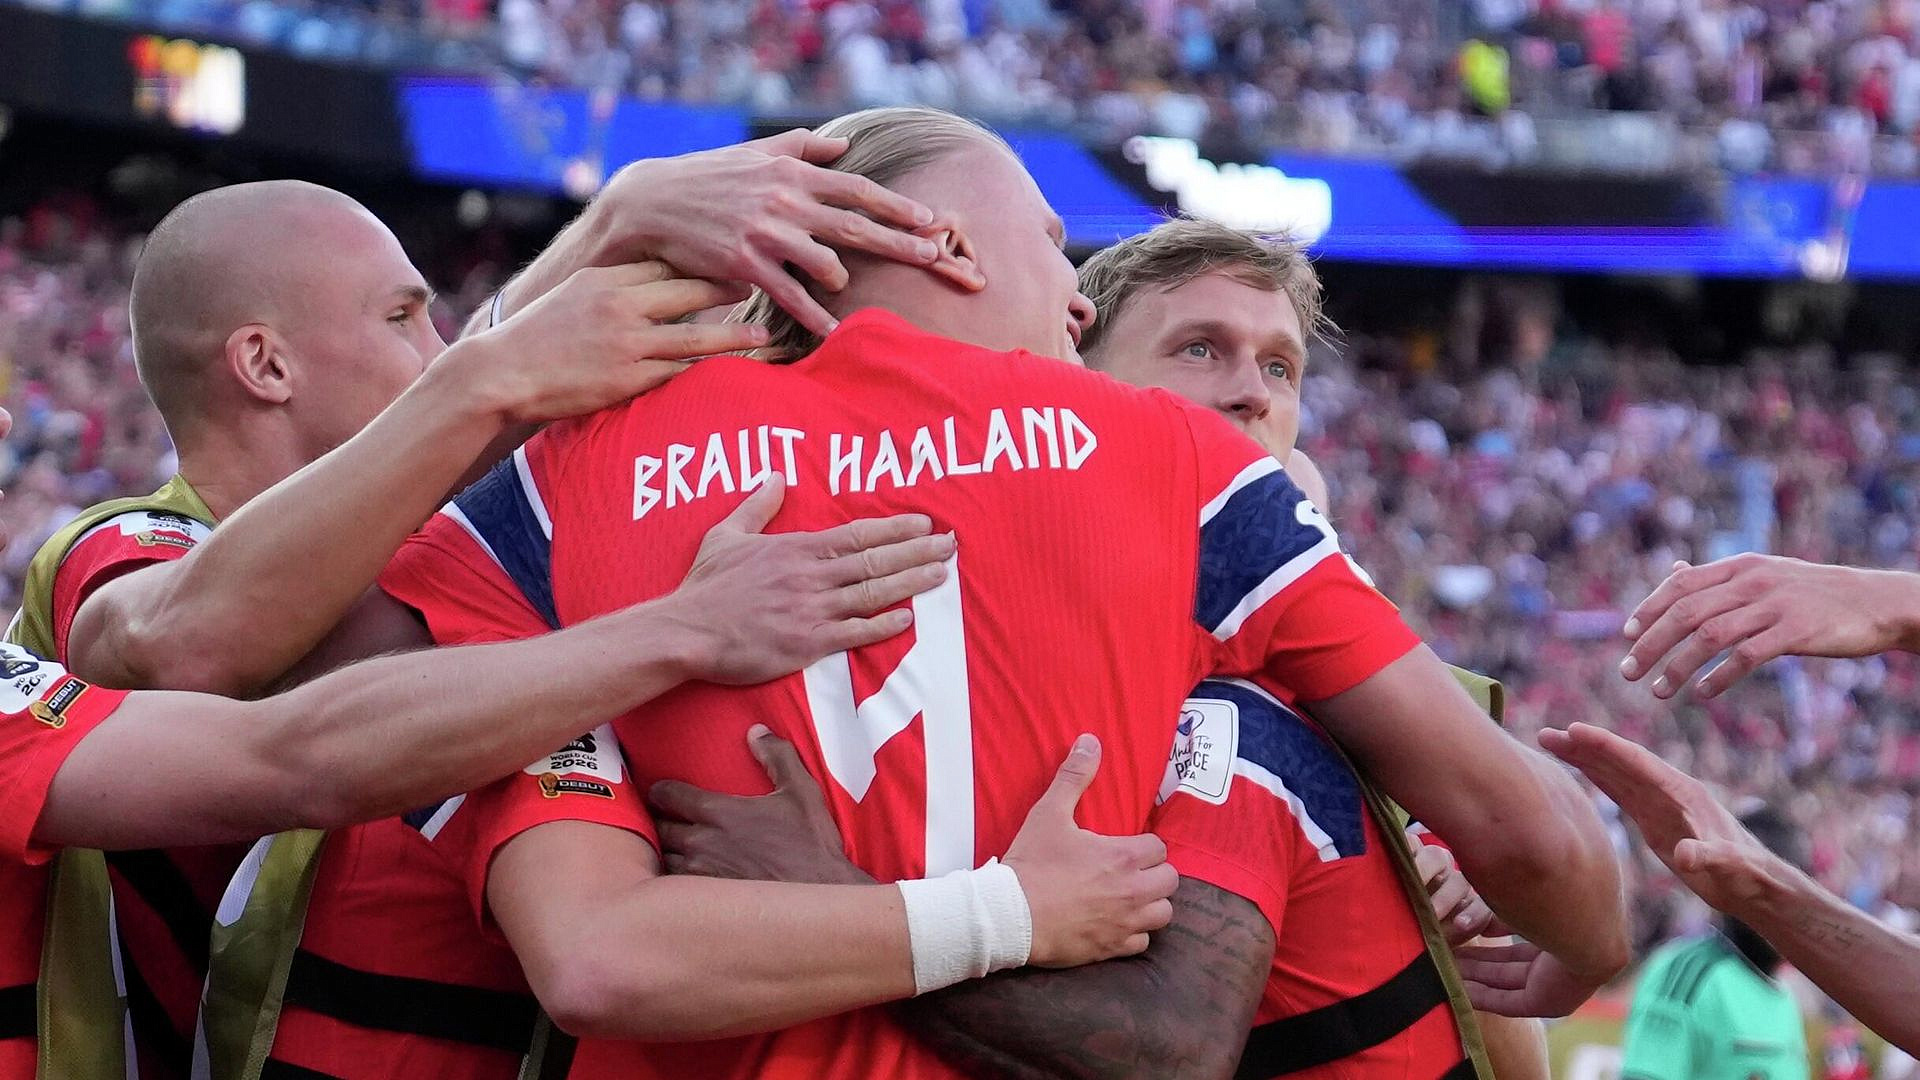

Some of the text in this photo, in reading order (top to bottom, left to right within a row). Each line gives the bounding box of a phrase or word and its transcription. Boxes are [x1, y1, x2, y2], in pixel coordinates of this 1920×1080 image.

[632, 406, 1098, 520] BRAUT HAALAND
[48, 679, 77, 710] DEBUT
[550, 753, 598, 762] WORLD CUP
[550, 759, 598, 770] 2026
[559, 780, 606, 791] DEBUT
